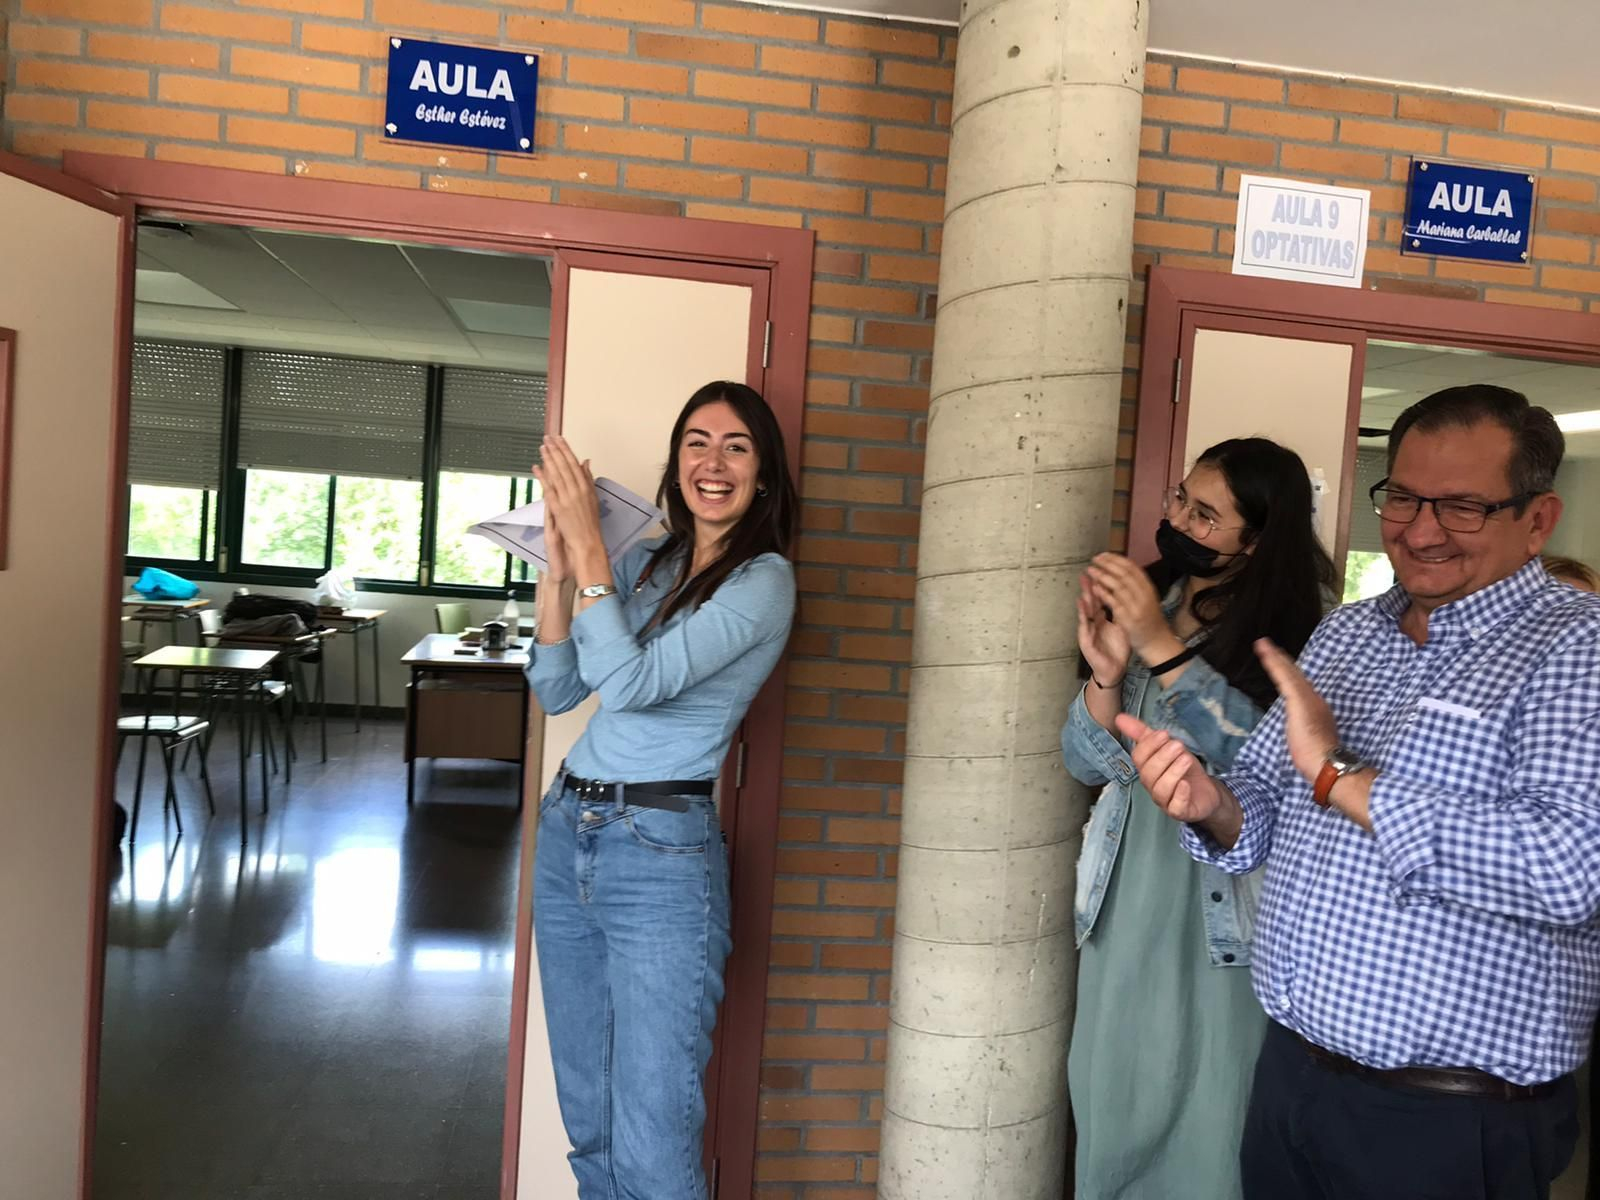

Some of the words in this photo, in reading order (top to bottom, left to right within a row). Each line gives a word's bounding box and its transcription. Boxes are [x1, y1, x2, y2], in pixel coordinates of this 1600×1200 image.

[409, 59, 515, 102] AULA
[415, 103, 456, 123] Esther
[1272, 194, 1323, 228] AULA
[1327, 200, 1340, 230] 9
[1428, 182, 1513, 218] AULA
[1416, 219, 1464, 240] Mariana
[1251, 229, 1354, 270] OPTATIVAS
